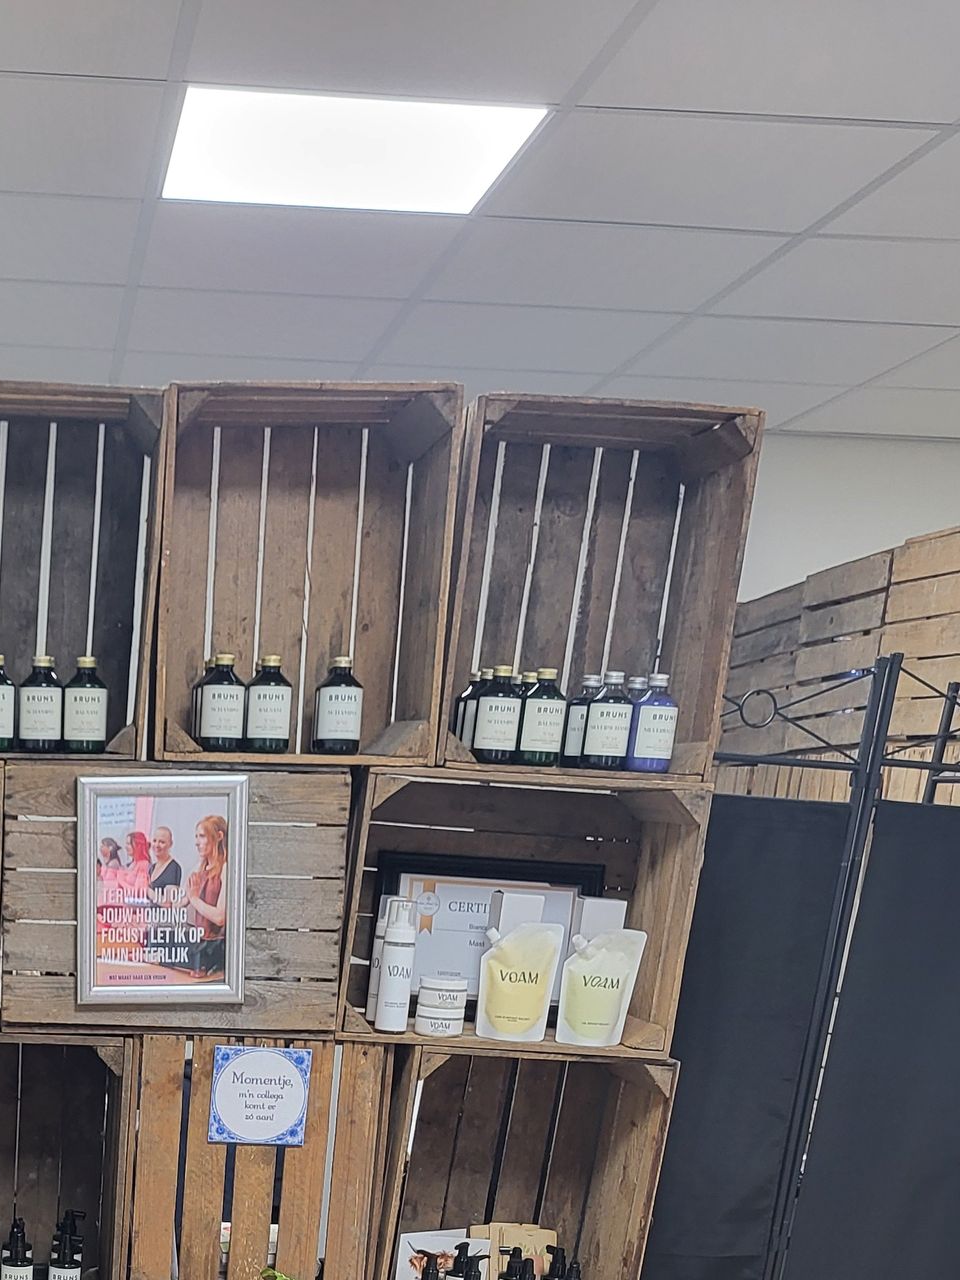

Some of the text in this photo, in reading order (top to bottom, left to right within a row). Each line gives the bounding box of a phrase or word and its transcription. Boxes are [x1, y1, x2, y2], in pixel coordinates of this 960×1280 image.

[26, 694, 54, 703] BRUNS
[73, 695, 101, 703] BRUNS
[212, 692, 239, 701] BRUNS
[257, 693, 285, 701] BRUNS
[328, 694, 357, 702] BRUNS
[488, 704, 516, 713] BRUNS
[599, 711, 627, 719] BRUNS
[102, 887, 186, 904] TERWIJL JIJ OP
[100, 907, 187, 923] JOUW HOUDING
[101, 927, 205, 946] FOCUST, LET IK OP
[101, 946, 189, 963] MIJN UITERLIJK
[499, 969, 539, 985] VOAM
[582, 975, 620, 989] VOAM
[437, 993, 458, 1002] VOAM
[430, 1020, 451, 1029] VOAM
[231, 1070, 294, 1090] Momentje,
[238, 1089, 284, 1103] m'n collega
[244, 1100, 266, 1110] komt
[244, 1113, 275, 1121] zó aan!
[4, 1273, 29, 1280] BRUNS
[52, 1273, 78, 1280] BRUNS
